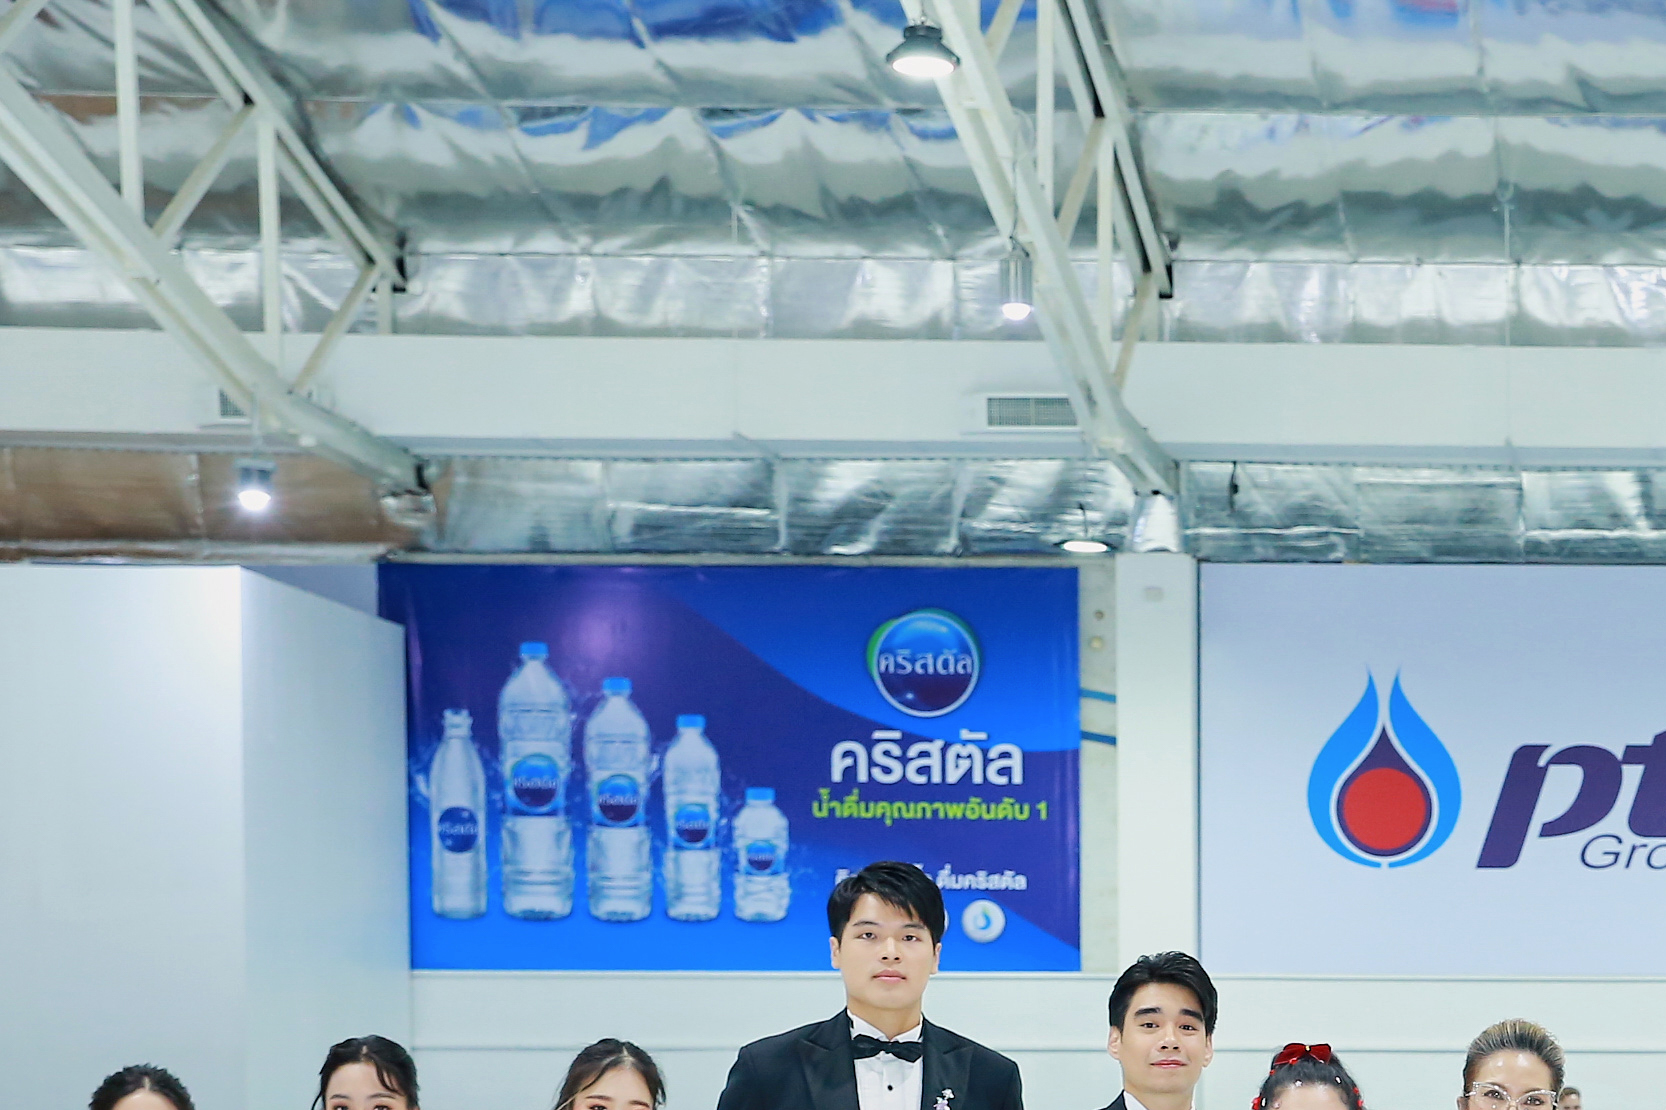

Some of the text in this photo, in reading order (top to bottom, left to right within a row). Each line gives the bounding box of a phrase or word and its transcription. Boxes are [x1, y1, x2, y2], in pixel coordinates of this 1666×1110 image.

[830, 728, 1024, 786] คริสตัล
[1036, 801, 1048, 821] 1
